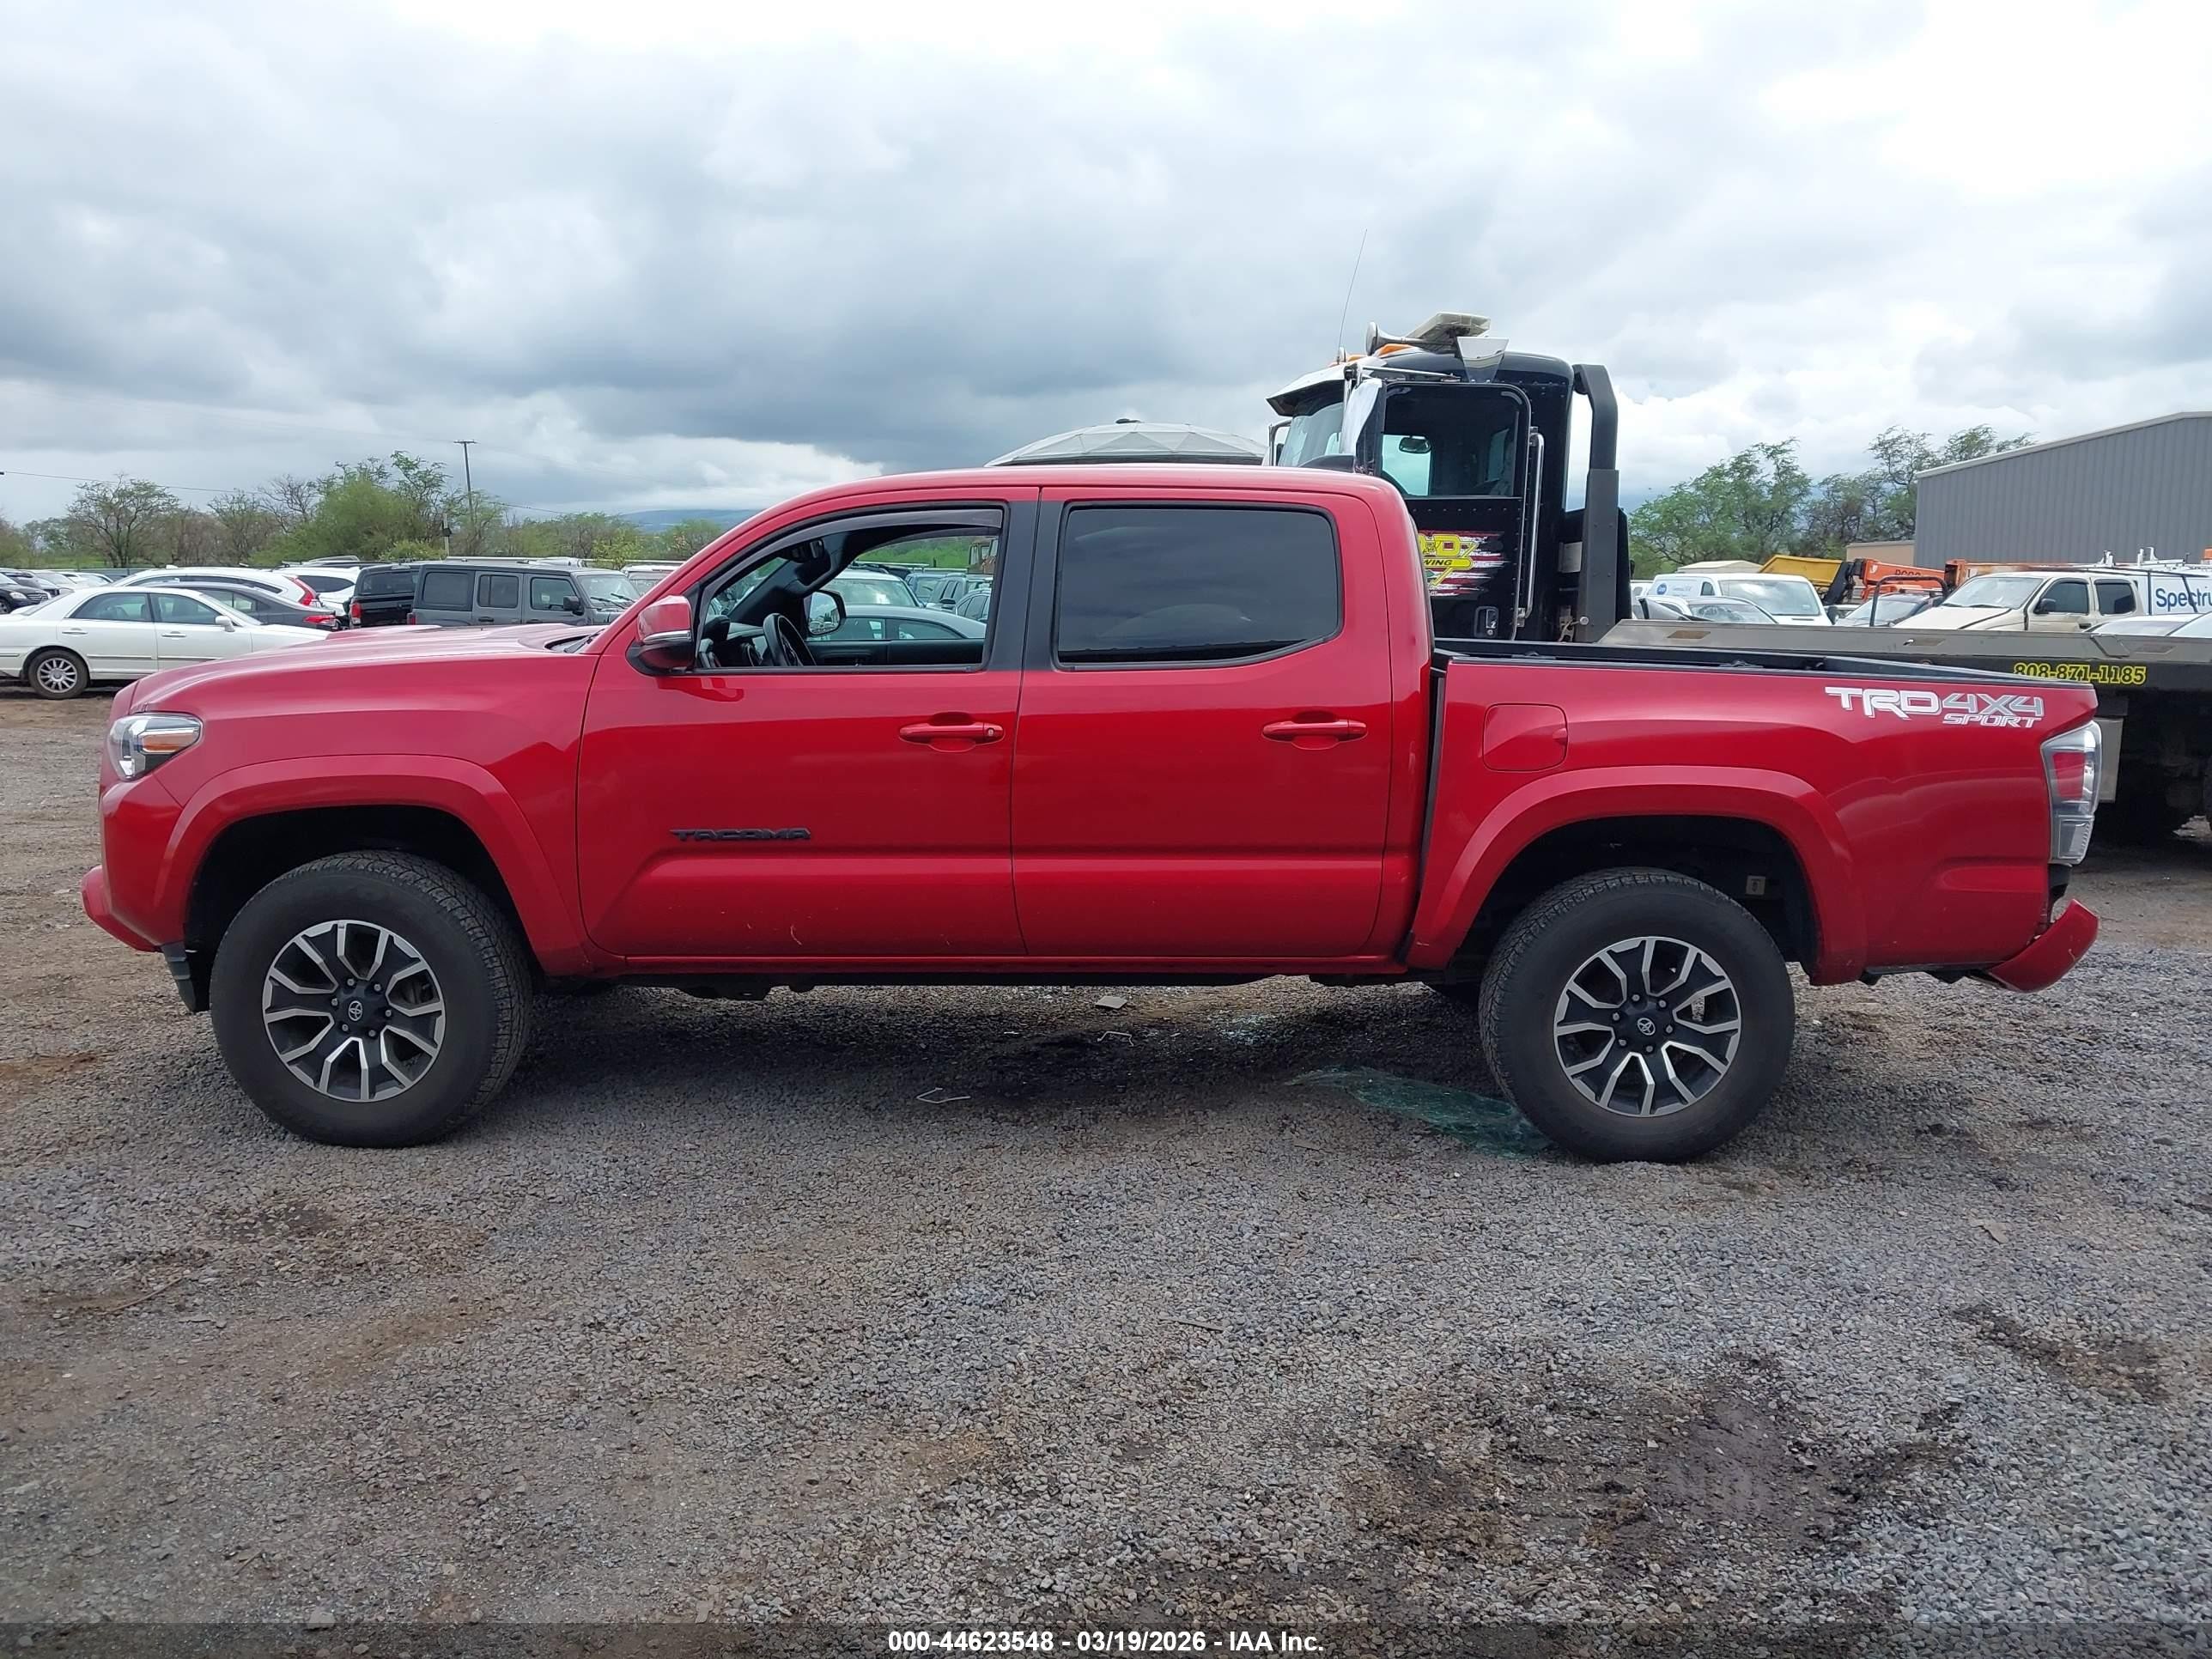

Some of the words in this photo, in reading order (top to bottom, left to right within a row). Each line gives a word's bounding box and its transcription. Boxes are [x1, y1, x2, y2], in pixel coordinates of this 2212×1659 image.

[2014, 663, 2147, 685] 808-871-1185
[1942, 714, 2043, 728] SPORT
[669, 828, 811, 842] TACOMA
